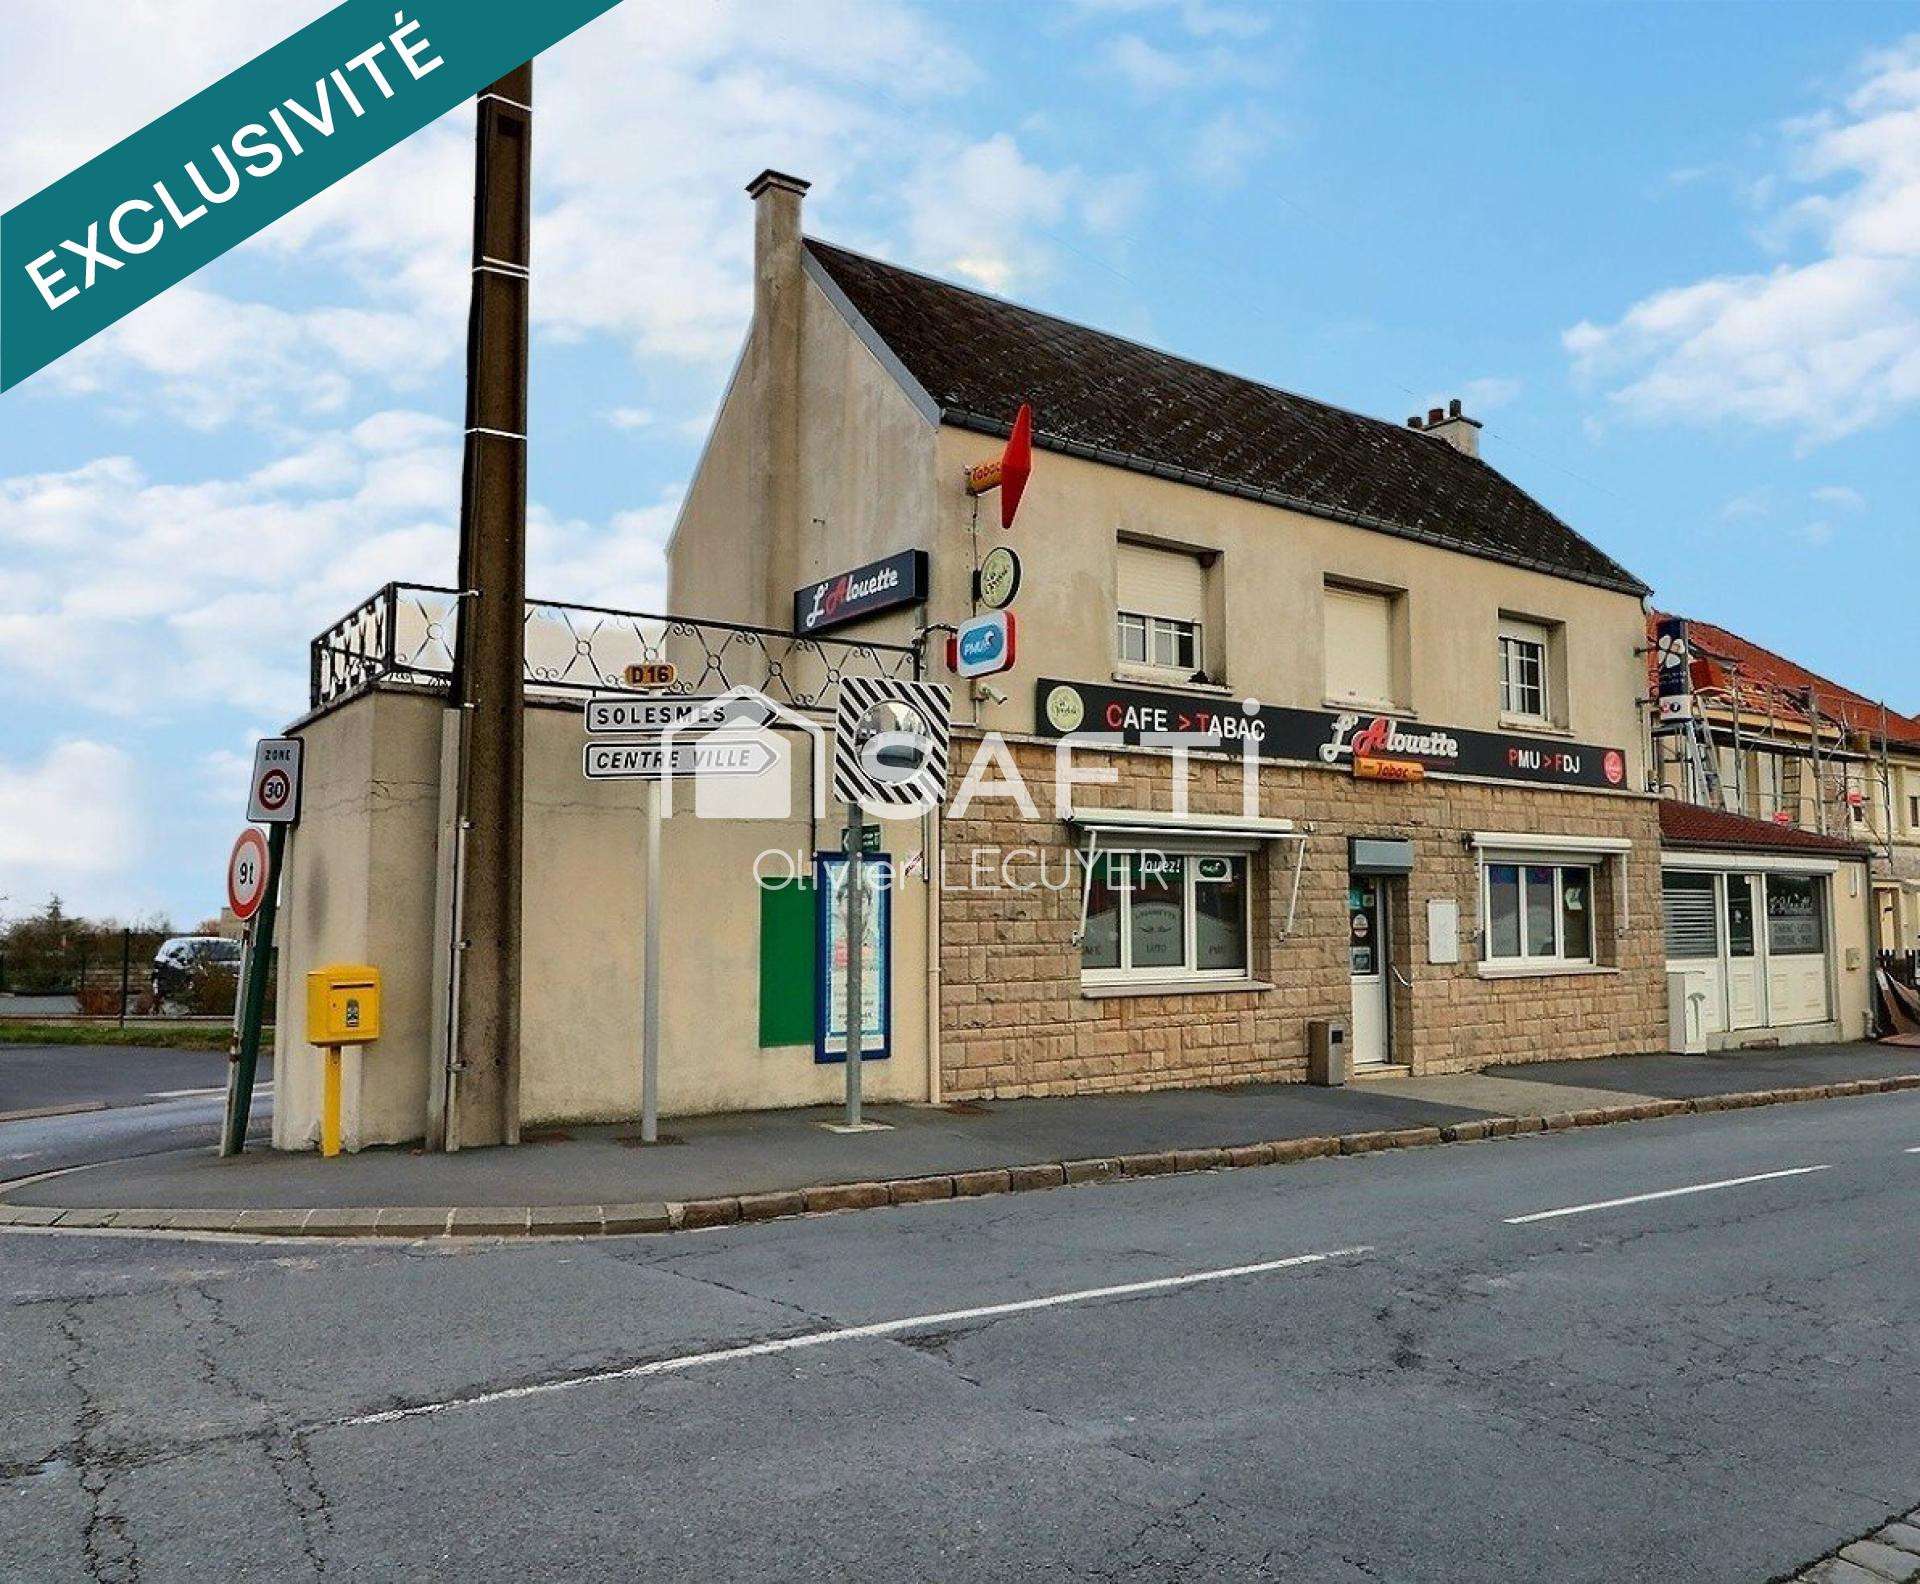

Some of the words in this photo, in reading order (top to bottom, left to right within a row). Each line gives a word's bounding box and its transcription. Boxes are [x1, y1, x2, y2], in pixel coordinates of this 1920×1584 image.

[806, 567, 899, 628] L'Alouette
[596, 706, 726, 725] SOLESMES
[1105, 700, 1168, 732] CAFE
[1196, 713, 1266, 743] TABAC
[1319, 711, 1459, 763] L'Alouette
[265, 749, 291, 761] ZONE
[596, 750, 680, 769] CENTRE
[693, 749, 751, 767] VILLE
[1508, 747, 1540, 770] PMU
[1555, 752, 1581, 774] FDJ
[1376, 761, 1409, 778] Tabac
[264, 781, 284, 799] 30
